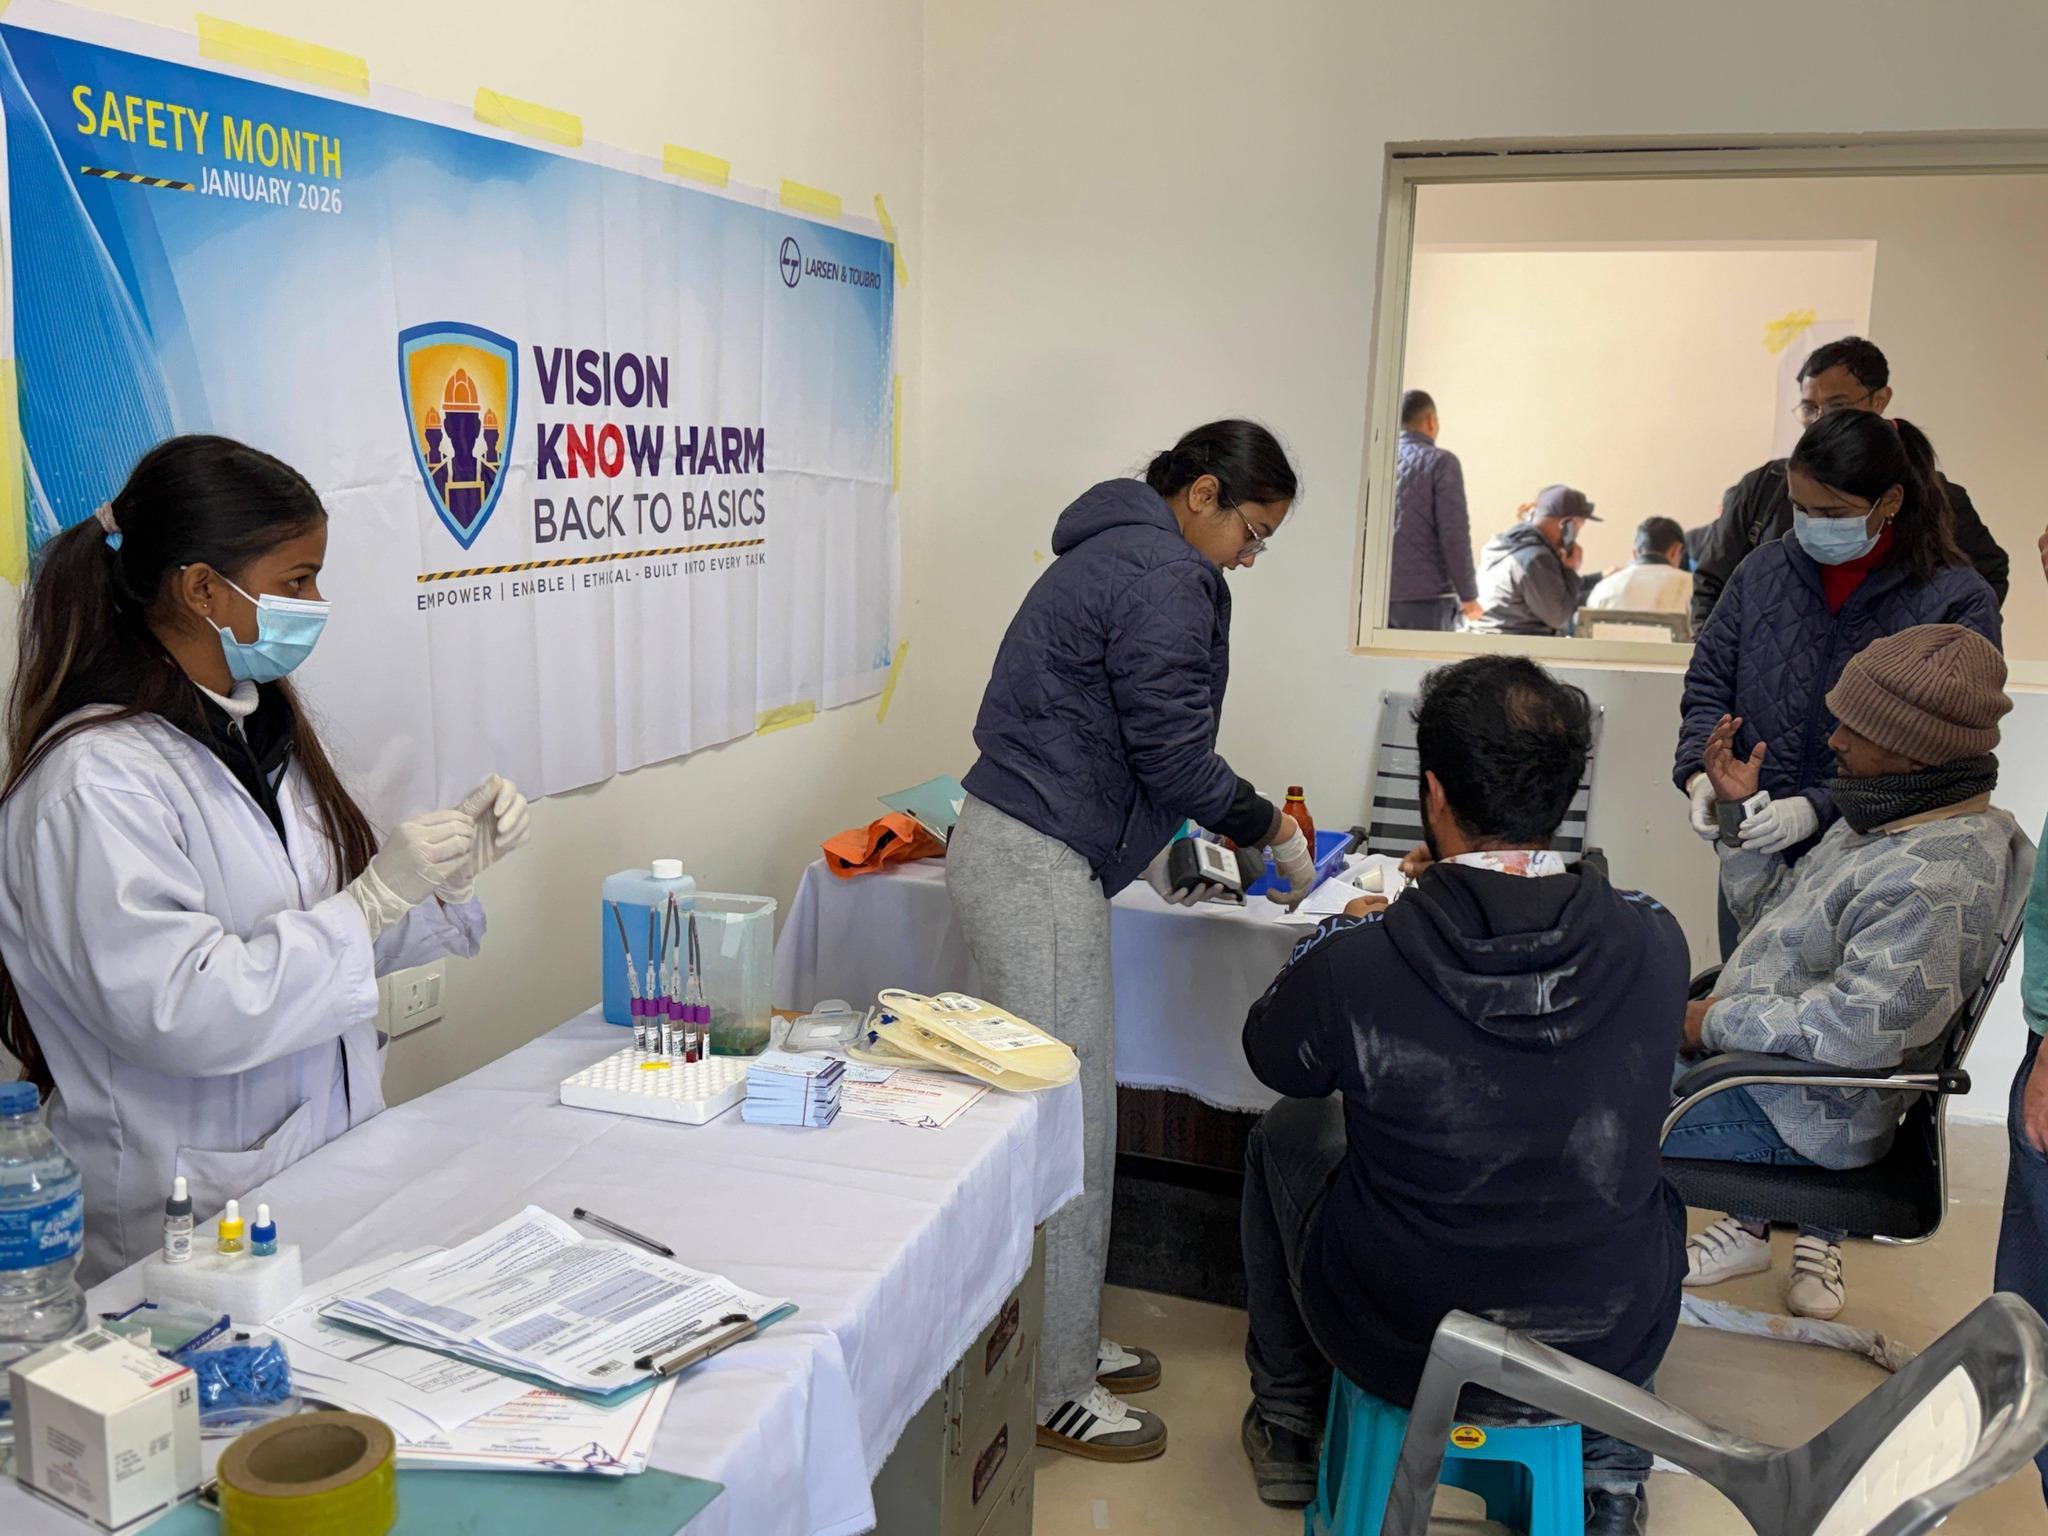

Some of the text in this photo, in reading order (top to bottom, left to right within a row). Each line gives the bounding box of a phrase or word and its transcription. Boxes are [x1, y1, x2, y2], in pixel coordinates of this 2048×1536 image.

[72, 86, 342, 179] SAFETY MONTH
[200, 166, 342, 214] JANUARY 2026
[804, 257, 881, 290] LARSEN & TOUBRO
[533, 345, 669, 409] VISION
[537, 423, 765, 480] KNOW HARM
[534, 488, 765, 544] BACK TO BASICS
[417, 585, 492, 610] EMPOWER
[512, 576, 564, 597] ENABLE
[584, 568, 631, 588] ETHICAL
[644, 563, 678, 579] BUILT
[685, 560, 706, 574] INTO
[711, 556, 741, 571] EVERY
[745, 552, 766, 567] TASK
